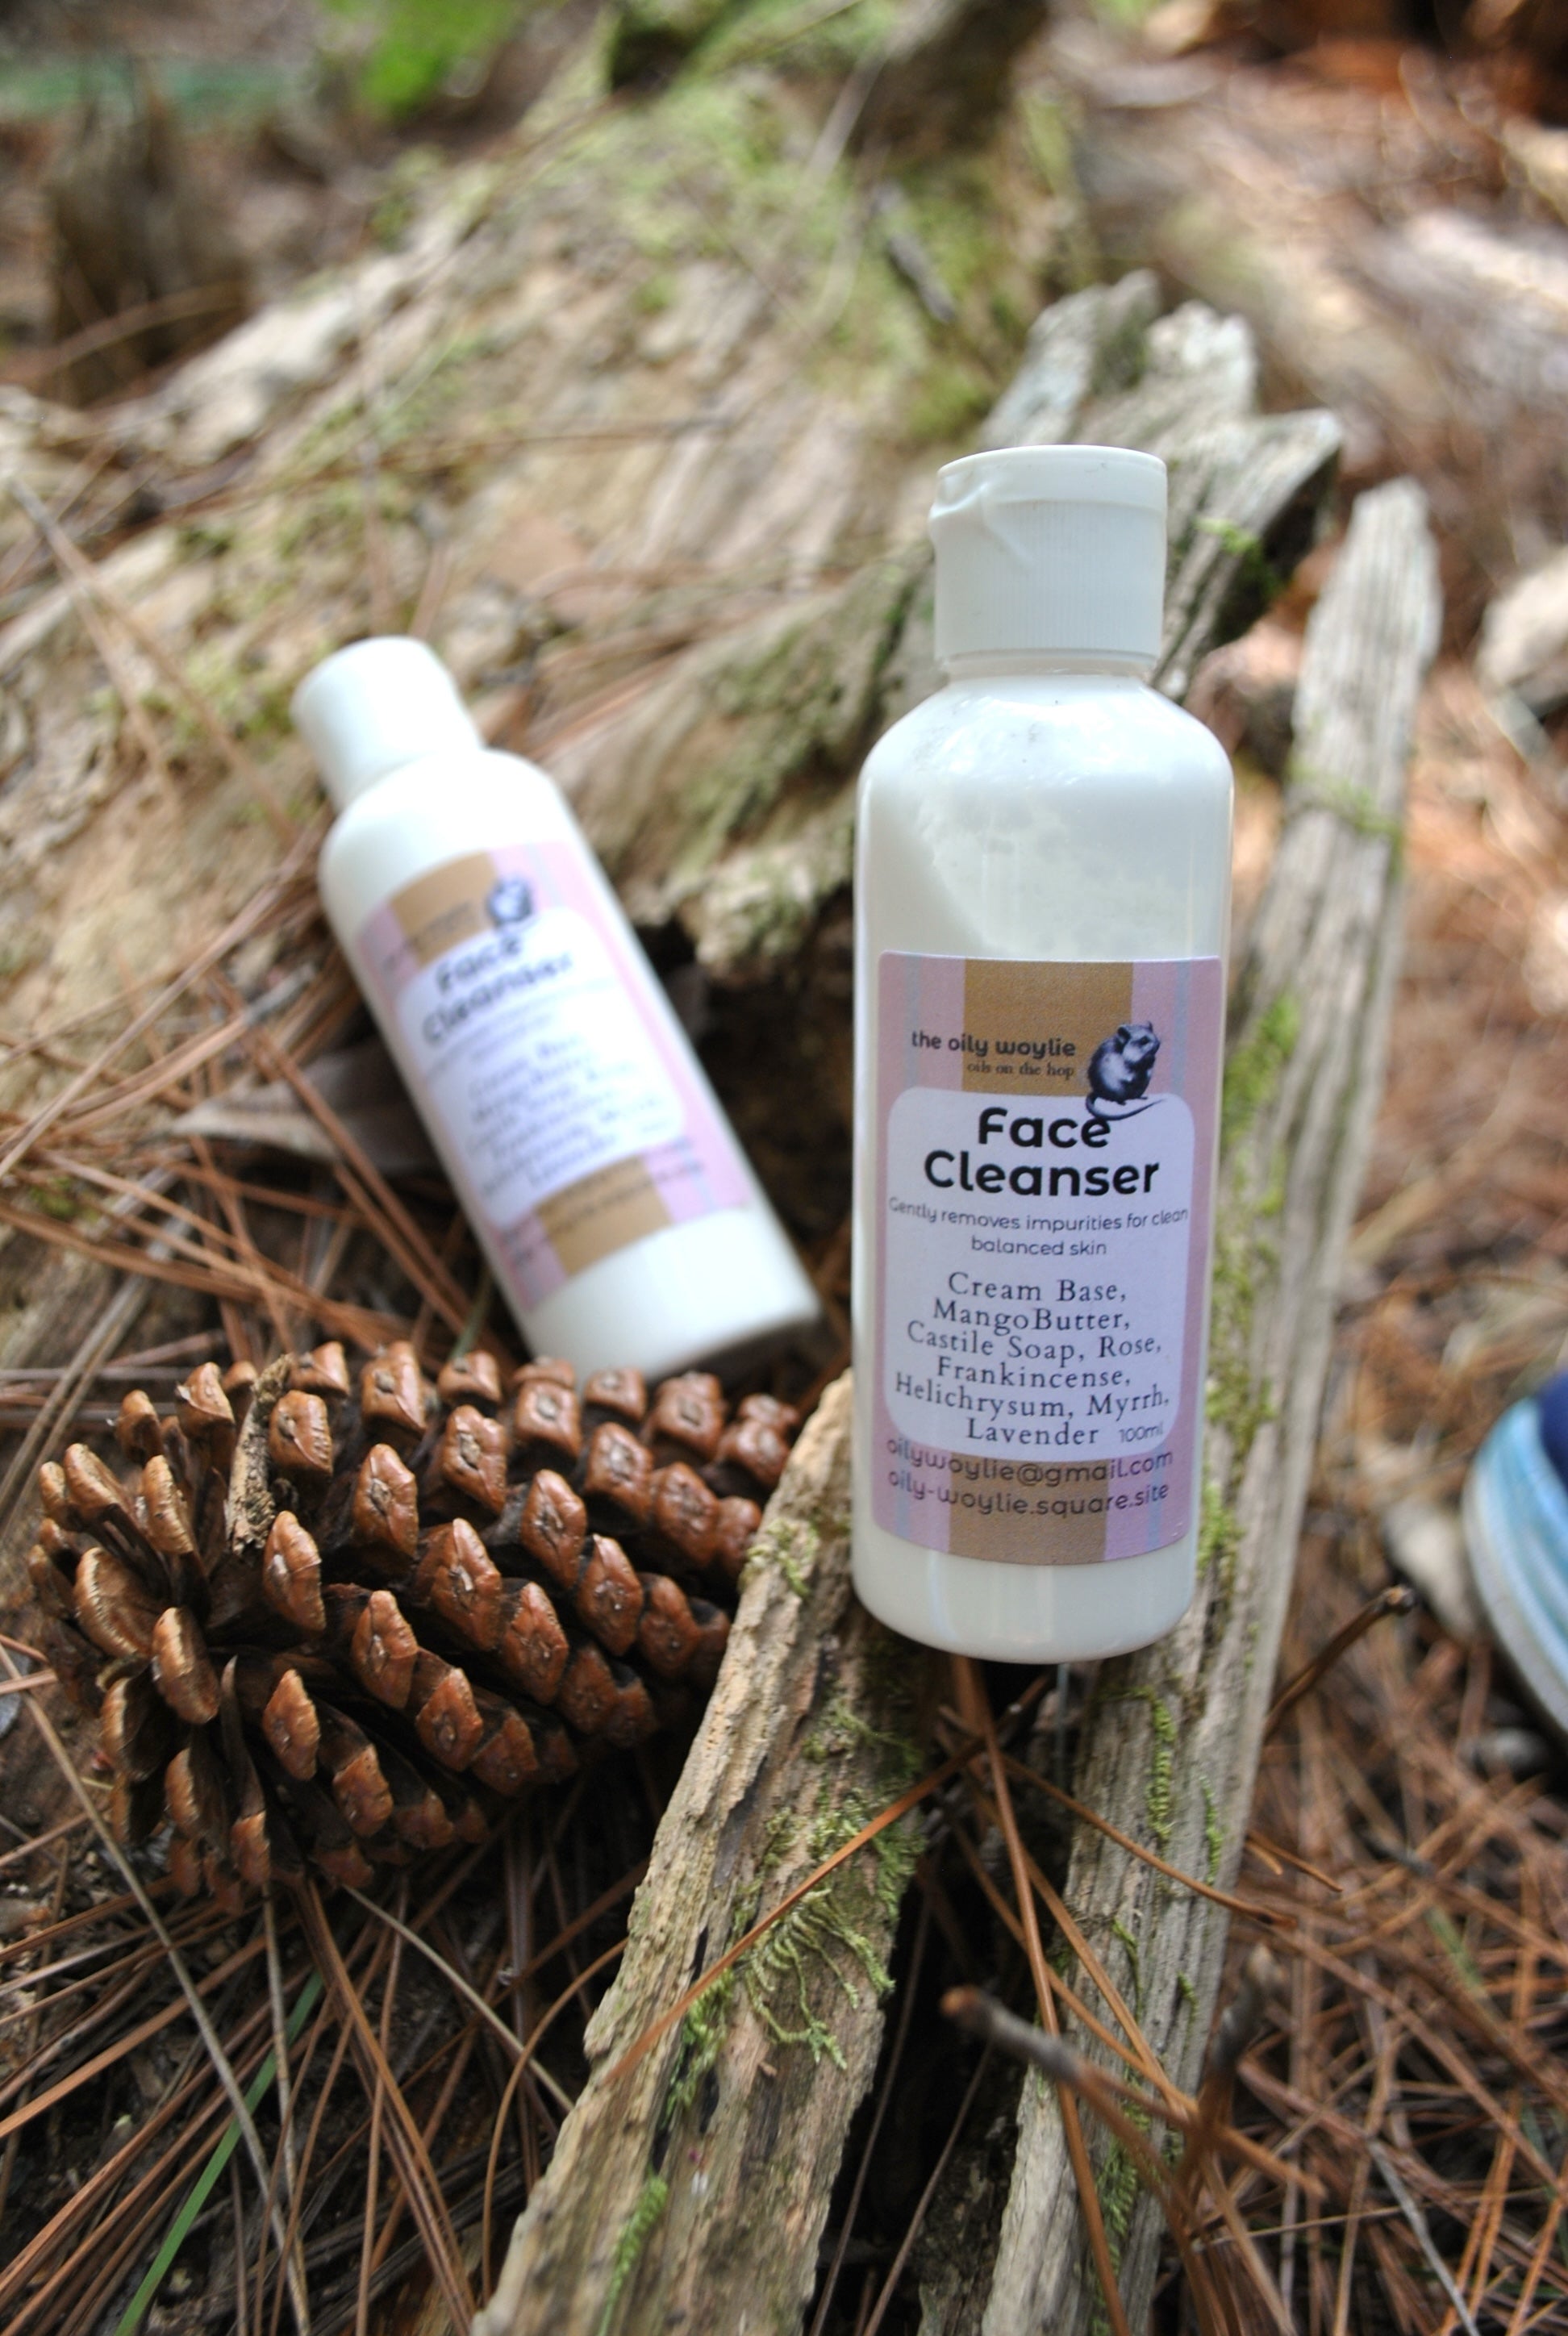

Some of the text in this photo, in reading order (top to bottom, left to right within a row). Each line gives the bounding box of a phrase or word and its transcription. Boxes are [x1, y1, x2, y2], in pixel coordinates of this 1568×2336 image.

[911, 1031, 1076, 1059] the oily woylie
[995, 1065, 1014, 1075] on
[1019, 1062, 1041, 1076] the
[1047, 1062, 1074, 1081] hop
[978, 1107, 1111, 1149] Face
[924, 1149, 1160, 1197] Cleanser
[888, 1197, 1189, 1233] Gently removes impurities for clean
[971, 1234, 1107, 1256] balanced skin
[948, 1271, 1126, 1303] Cream Base,
[933, 1298, 1130, 1336] MangoButter,
[907, 1320, 1161, 1368] Castile Soap, Rose,
[937, 1356, 1131, 1388] Frankincense,
[895, 1372, 1170, 1422] Helichrysum, Myrrh,
[967, 1418, 1099, 1445] Lavender
[888, 1438, 1173, 1487] oilywoylie@gmail.com
[889, 1470, 1169, 1518] oily-woylie.square.site
